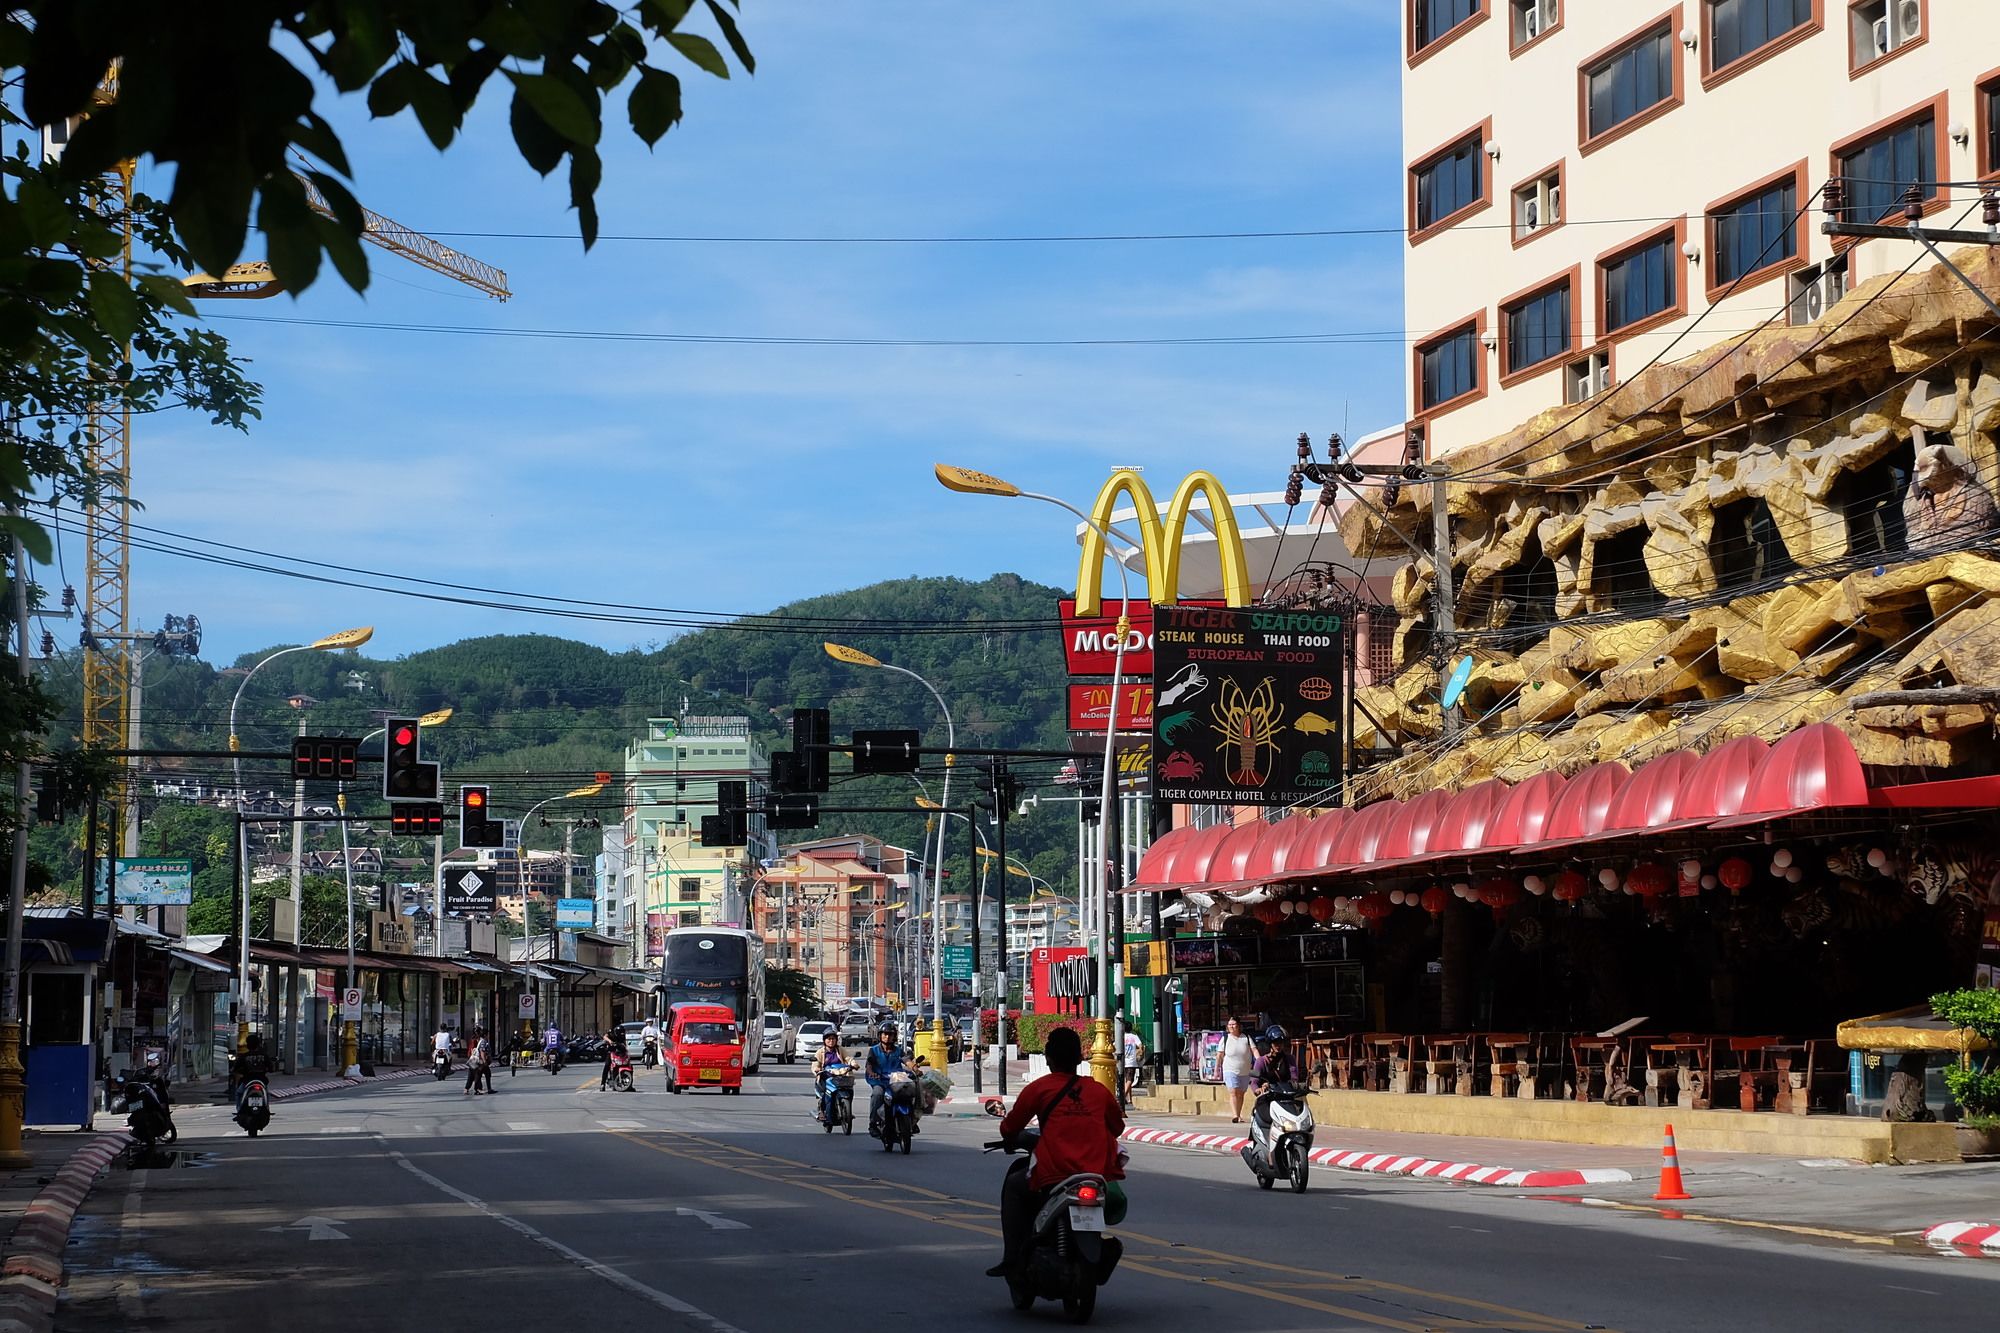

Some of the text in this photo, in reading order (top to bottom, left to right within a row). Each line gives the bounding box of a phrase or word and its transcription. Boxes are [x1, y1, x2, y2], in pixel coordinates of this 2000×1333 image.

[1169, 610, 1341, 633] TIGER SEAFOOD
[1074, 630, 1153, 652] McD
[1159, 630, 1245, 645] STEAK HOUSE
[1263, 634, 1331, 647] THAI FOOD
[1187, 649, 1315, 663] EUROPEAN FOOD
[1159, 788, 1340, 803] TIGER COMPLEX HOTEL & RESTAURANT
